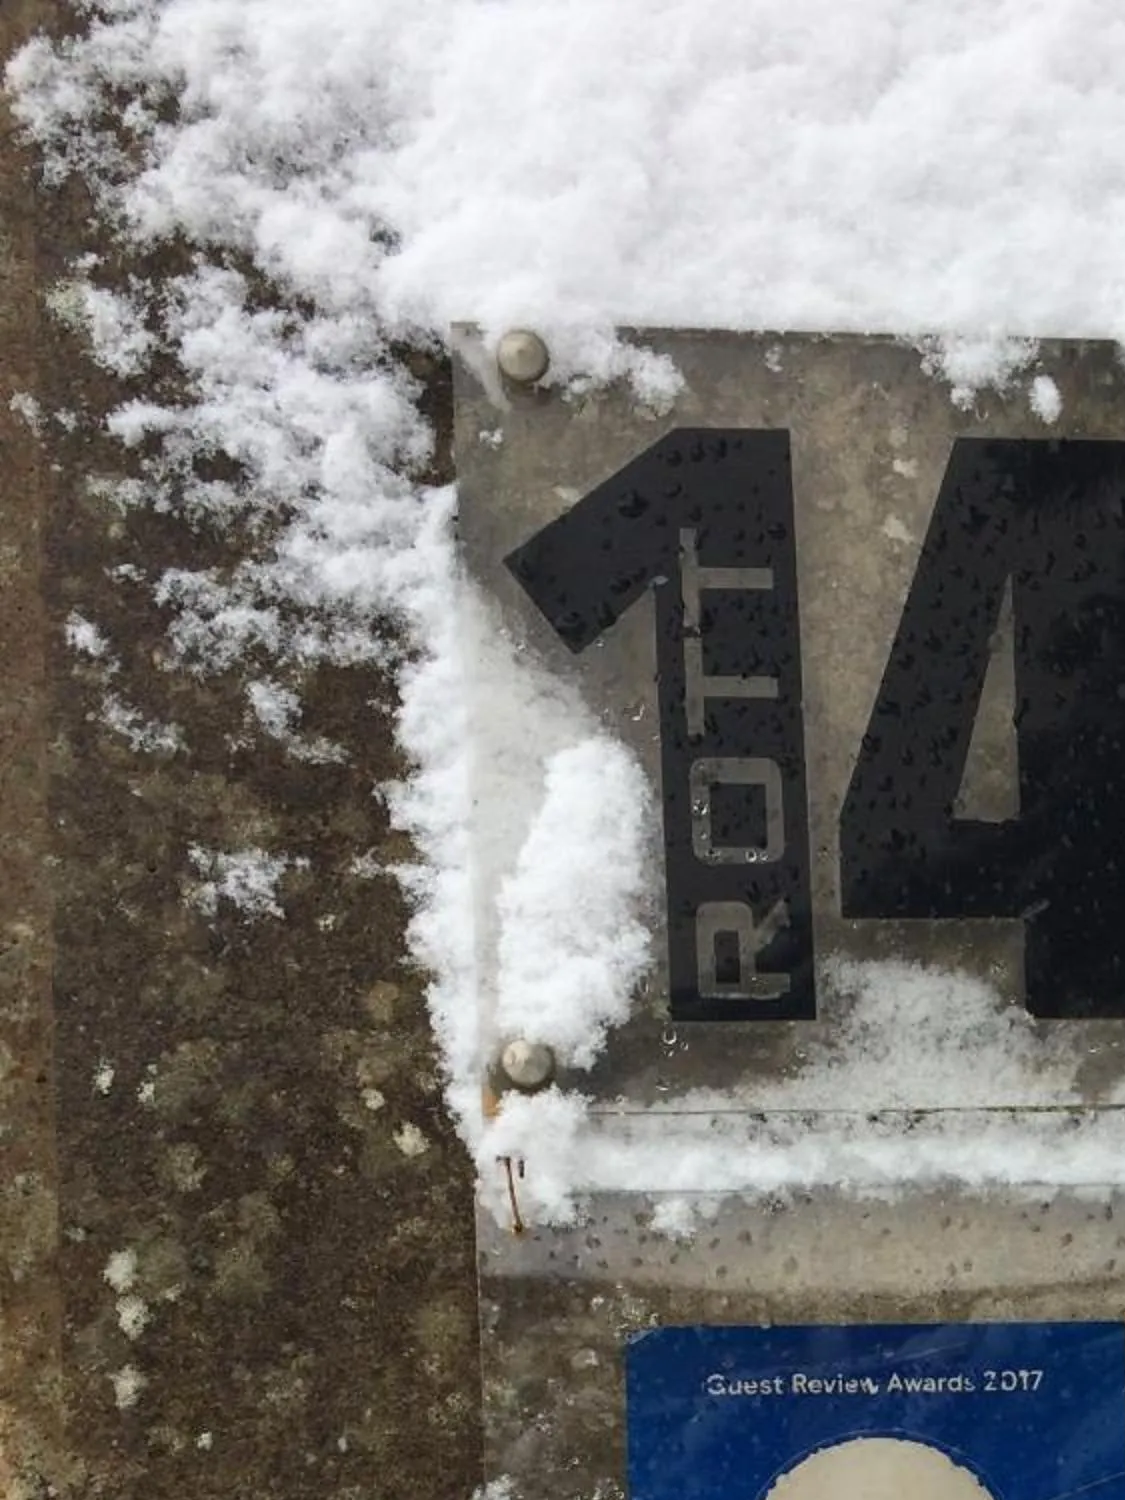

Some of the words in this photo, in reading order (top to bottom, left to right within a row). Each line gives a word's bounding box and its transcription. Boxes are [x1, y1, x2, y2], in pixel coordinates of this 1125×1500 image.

[678, 527, 791, 999] ROTT
[706, 1373, 784, 1396] Guest
[791, 1373, 879, 1395] Review
[886, 1371, 976, 1393] Awards
[983, 1369, 1044, 1392] 2017
